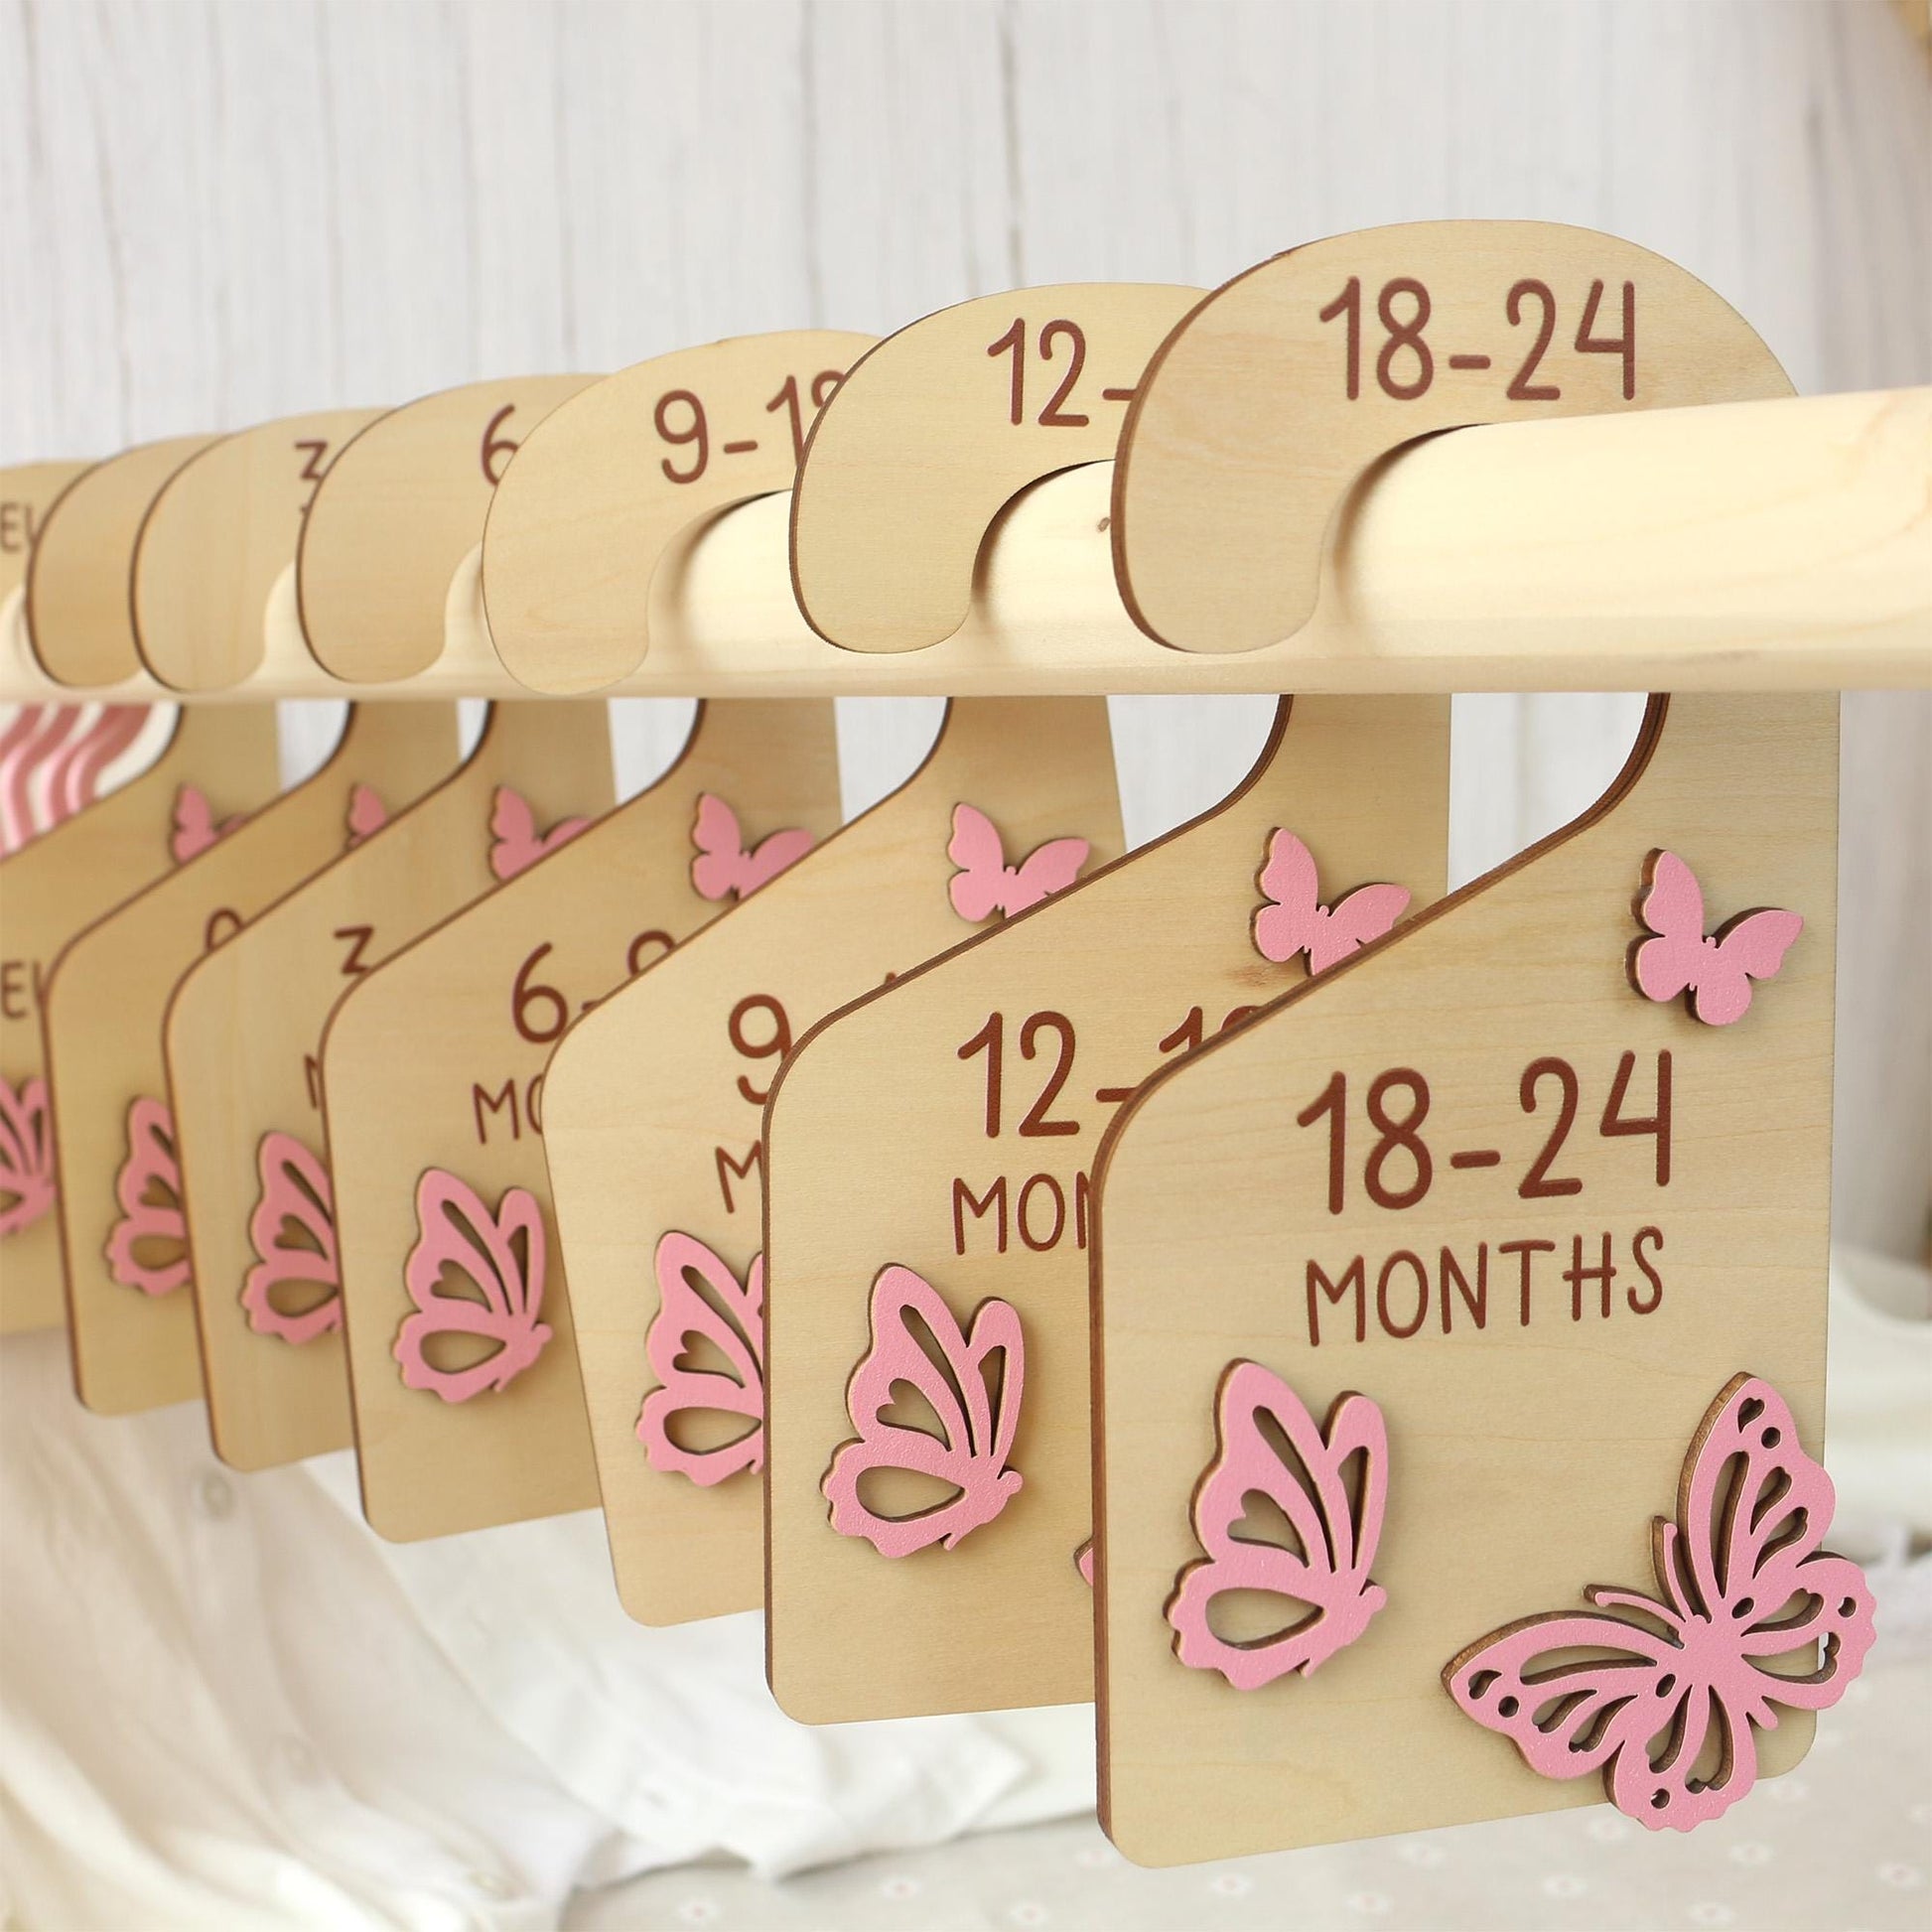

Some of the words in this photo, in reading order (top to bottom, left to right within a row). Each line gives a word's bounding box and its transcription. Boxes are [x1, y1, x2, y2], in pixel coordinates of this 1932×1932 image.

[1318, 275, 1635, 401] 18-24
[1297, 1049, 1672, 1215] 18-24
[1307, 1225, 1665, 1347] MONTHS
